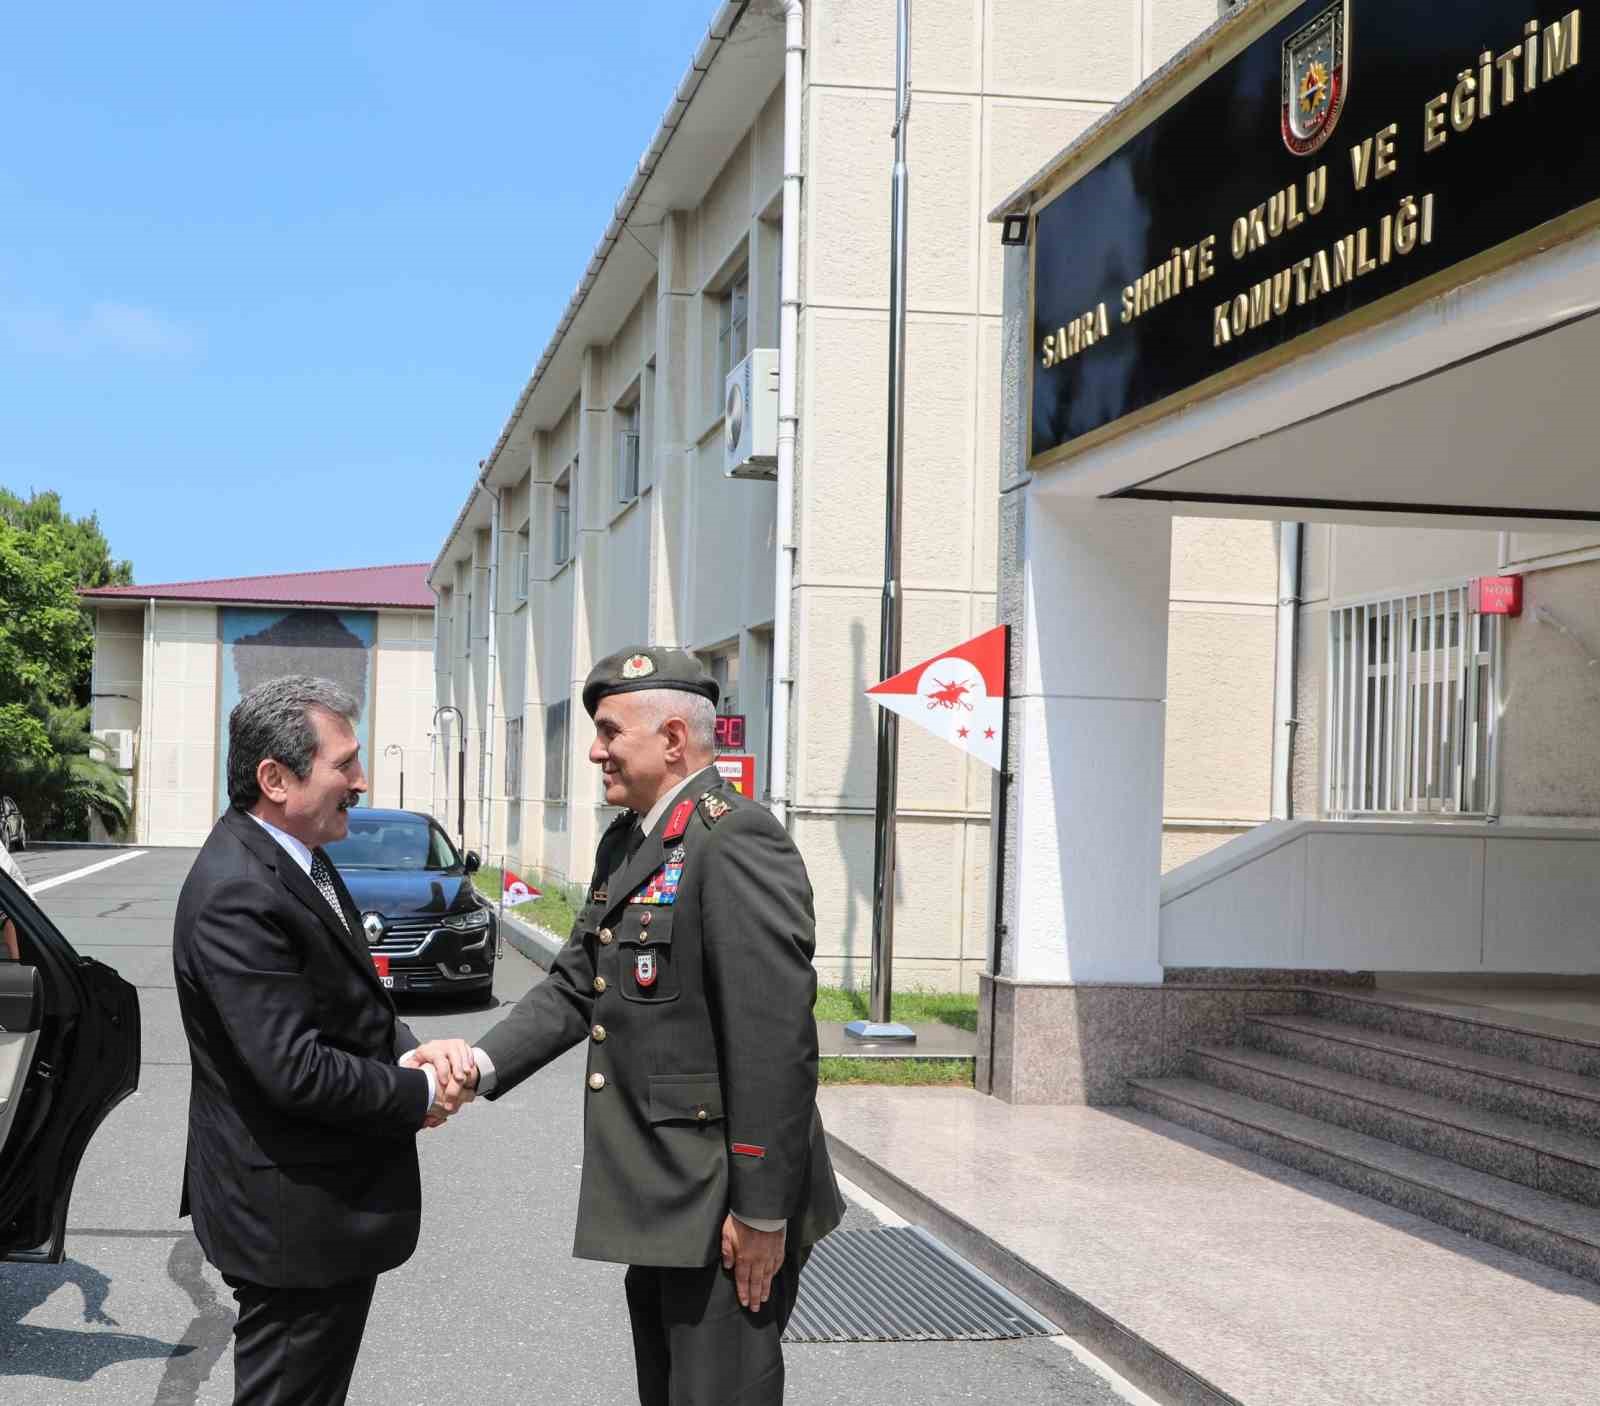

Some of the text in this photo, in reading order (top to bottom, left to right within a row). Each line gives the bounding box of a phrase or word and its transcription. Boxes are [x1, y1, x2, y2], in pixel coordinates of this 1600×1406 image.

[1231, 165, 1326, 260] OKULU
[1350, 122, 1397, 191] VE
[1424, 8, 1580, 152] EĞİTİM
[1214, 193, 1433, 348] KOMUTANLIĞI
